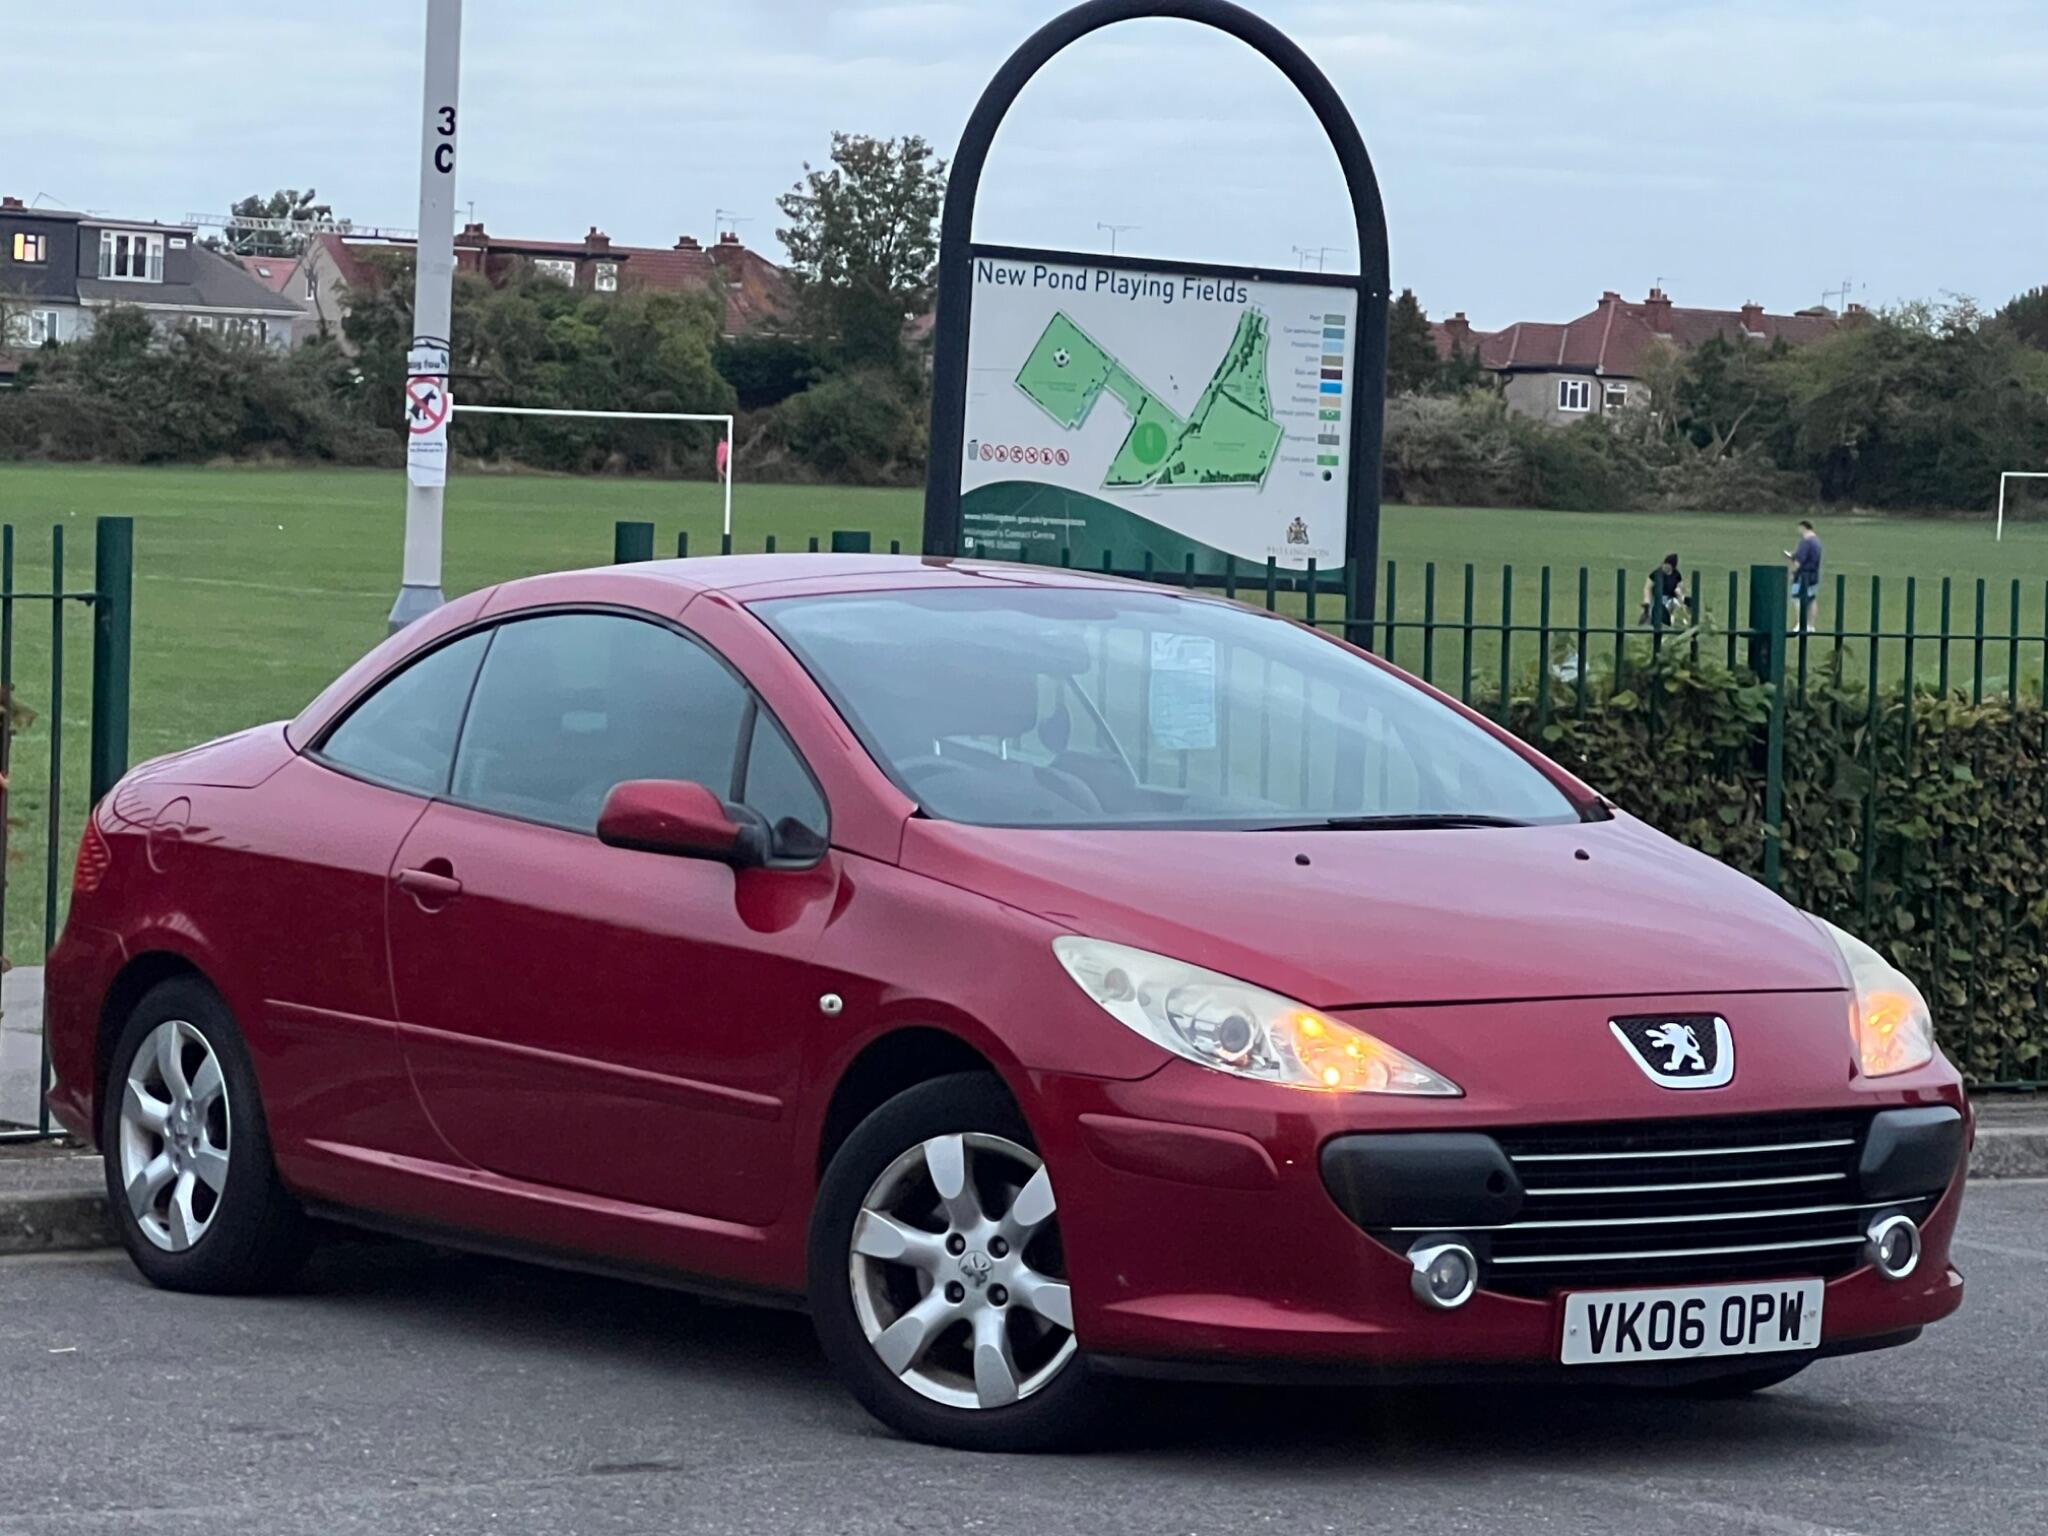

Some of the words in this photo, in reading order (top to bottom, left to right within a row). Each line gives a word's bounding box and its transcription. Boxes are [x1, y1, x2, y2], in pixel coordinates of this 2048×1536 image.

[437, 106, 456, 136] 3
[435, 143, 454, 174] C
[977, 260, 1026, 286] New
[1033, 265, 1088, 292] Pond
[1095, 270, 1175, 304] Playing
[1182, 276, 1248, 304] Fields
[1587, 1298, 1707, 1355] VK06
[1720, 1290, 1804, 1347] OPW
